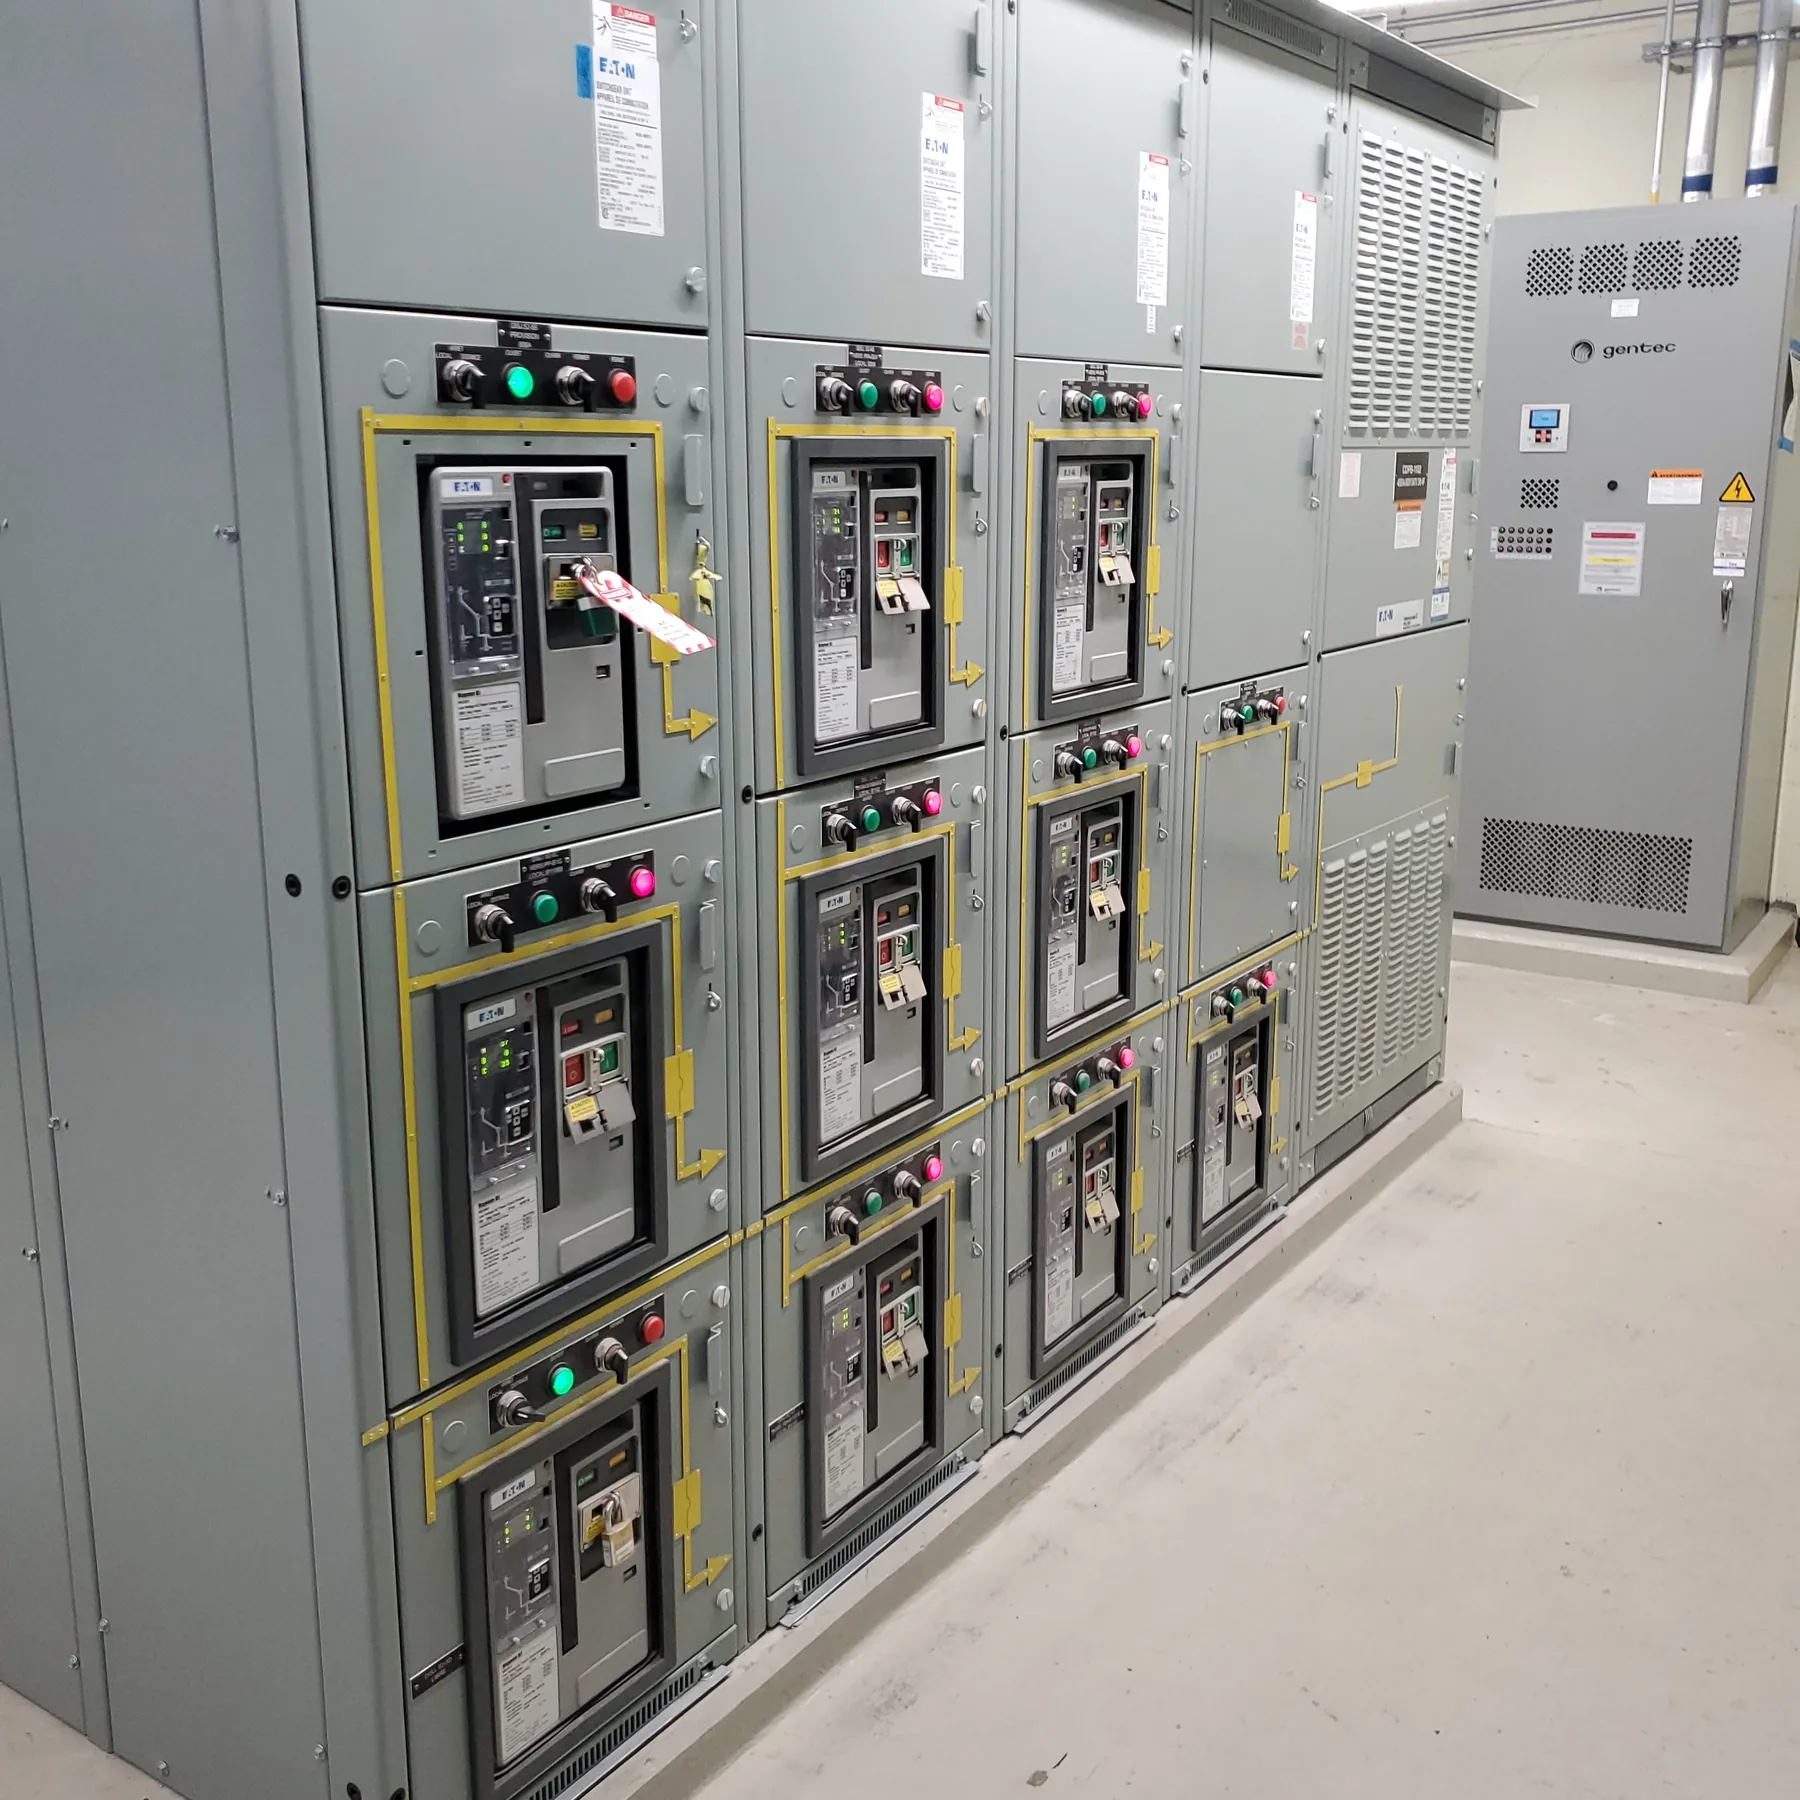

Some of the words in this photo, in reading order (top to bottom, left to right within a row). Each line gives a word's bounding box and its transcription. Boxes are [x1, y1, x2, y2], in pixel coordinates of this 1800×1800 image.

[1602, 341, 1677, 360] gentec
[454, 481, 481, 493] EATON
[479, 1005, 505, 1024] EATON
